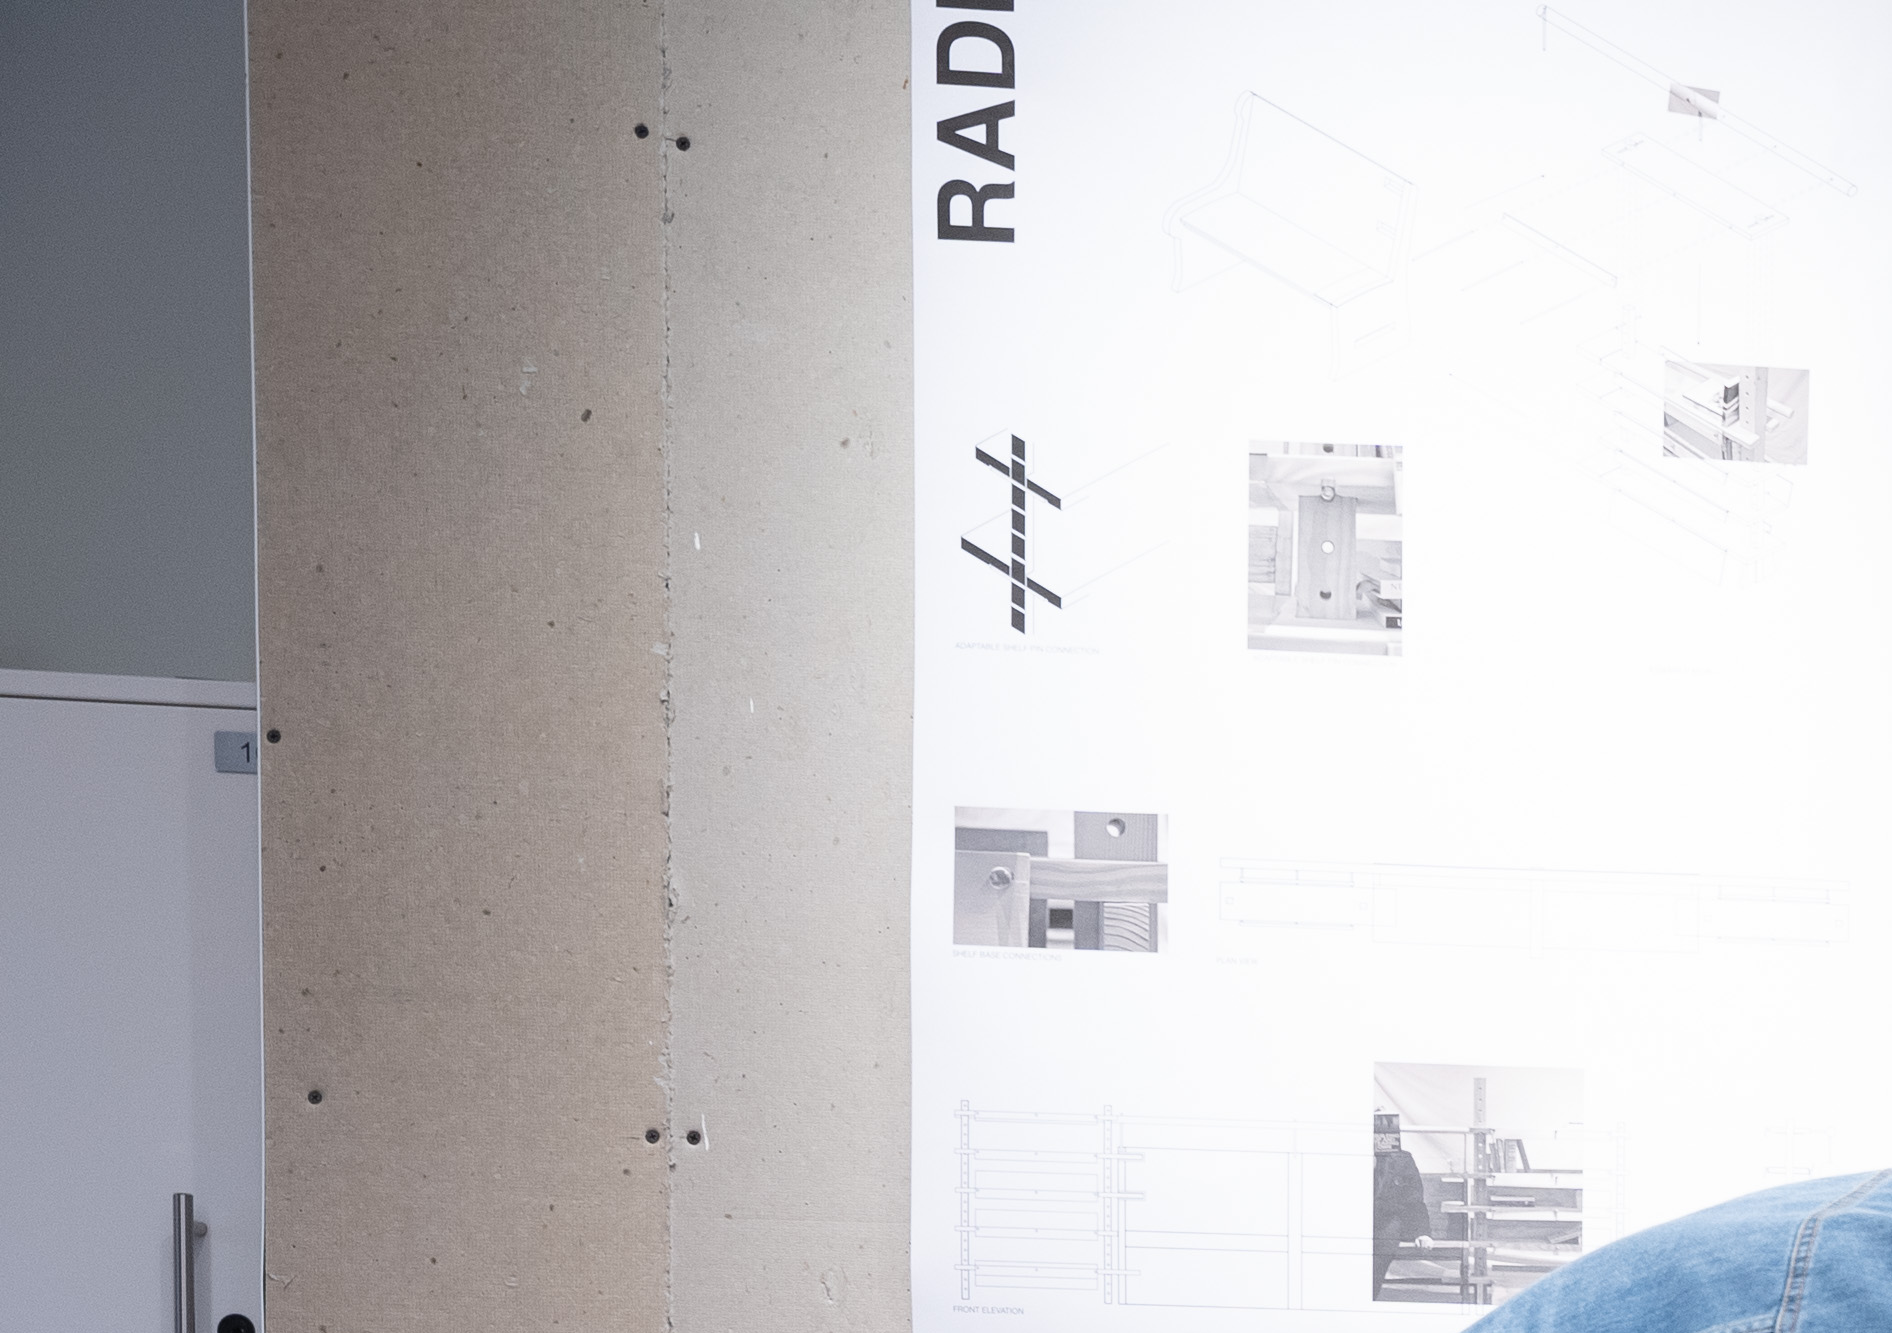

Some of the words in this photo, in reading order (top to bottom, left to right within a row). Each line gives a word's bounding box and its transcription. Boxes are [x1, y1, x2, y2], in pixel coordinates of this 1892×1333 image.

[955, 641, 1000, 651] ADAPTABLE
[240, 741, 258, 763] 1
[952, 1305, 980, 1314] FRONT
[981, 1305, 1025, 1315] ELEVATION
